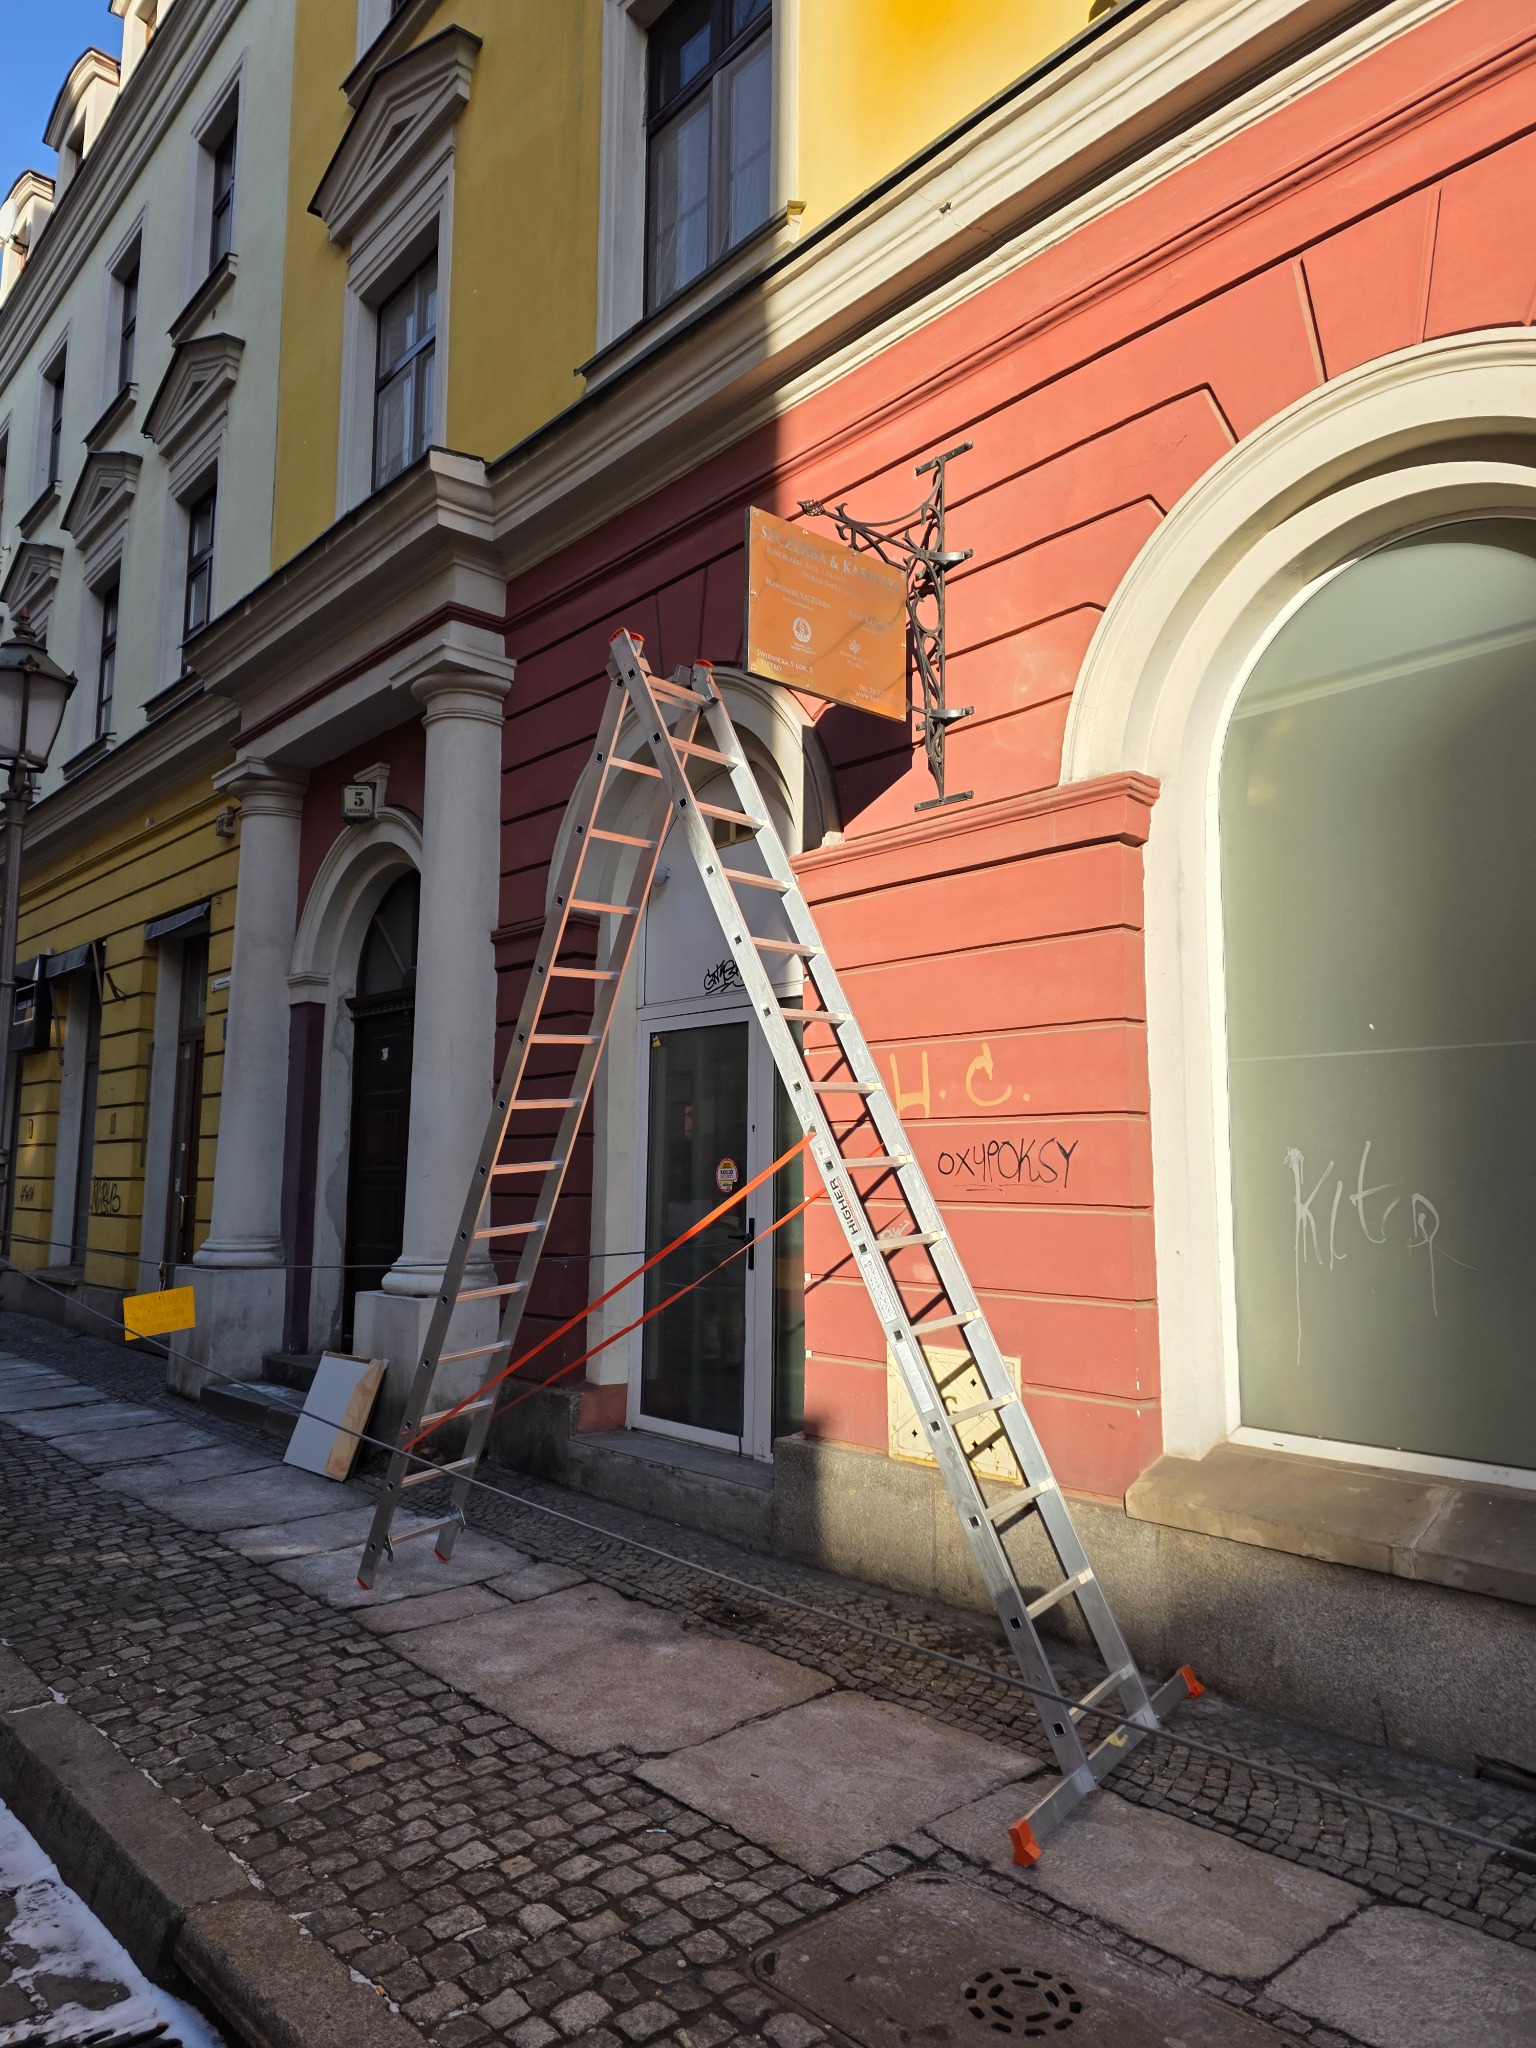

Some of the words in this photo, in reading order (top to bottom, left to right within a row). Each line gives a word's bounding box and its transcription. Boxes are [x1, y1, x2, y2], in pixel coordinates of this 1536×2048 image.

[829, 553, 839, 569] &
[799, 591, 831, 610] SZCZERBA
[756, 647, 789, 666] ŚWIDNICKA
[354, 791, 365, 807] 5
